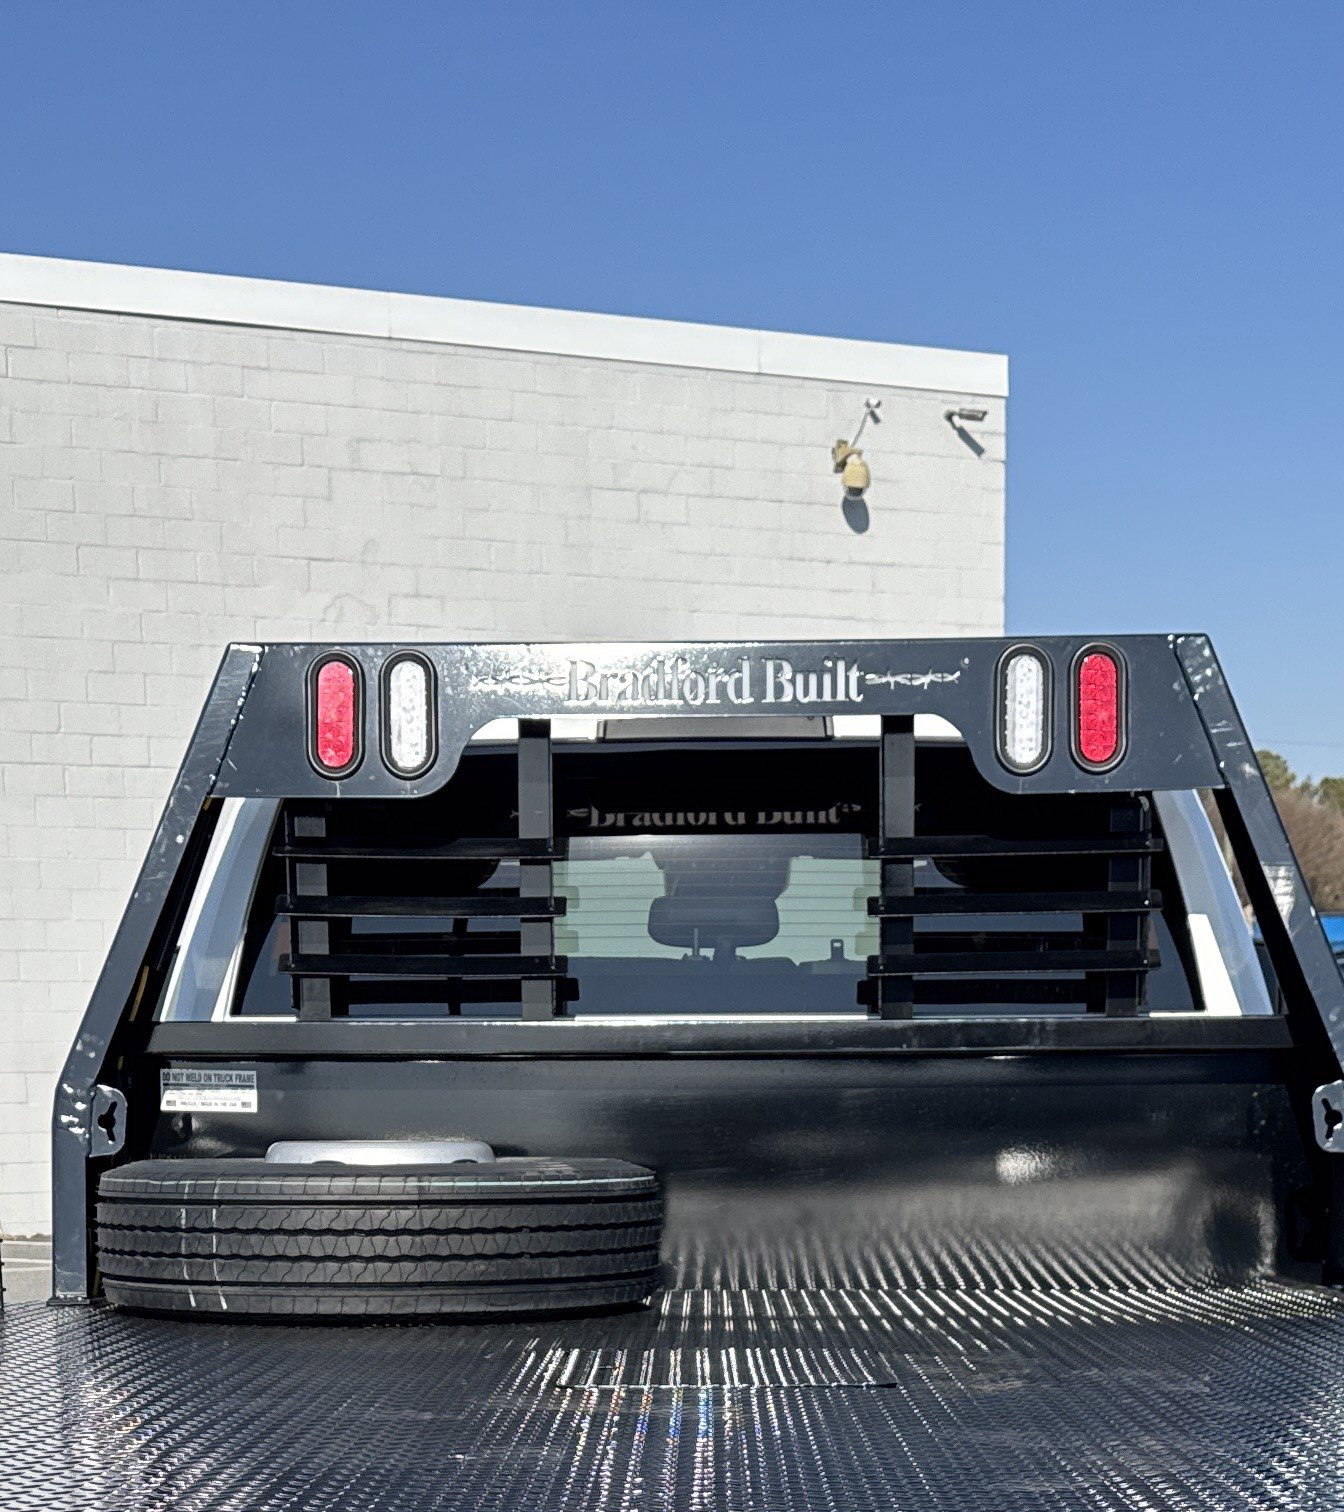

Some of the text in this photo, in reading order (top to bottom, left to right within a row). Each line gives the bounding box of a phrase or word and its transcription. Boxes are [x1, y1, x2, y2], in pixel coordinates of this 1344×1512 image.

[565, 656, 864, 705] Bradford Built
[213, 1073, 234, 1083] TRUCK
[235, 1073, 255, 1083] FRAME
